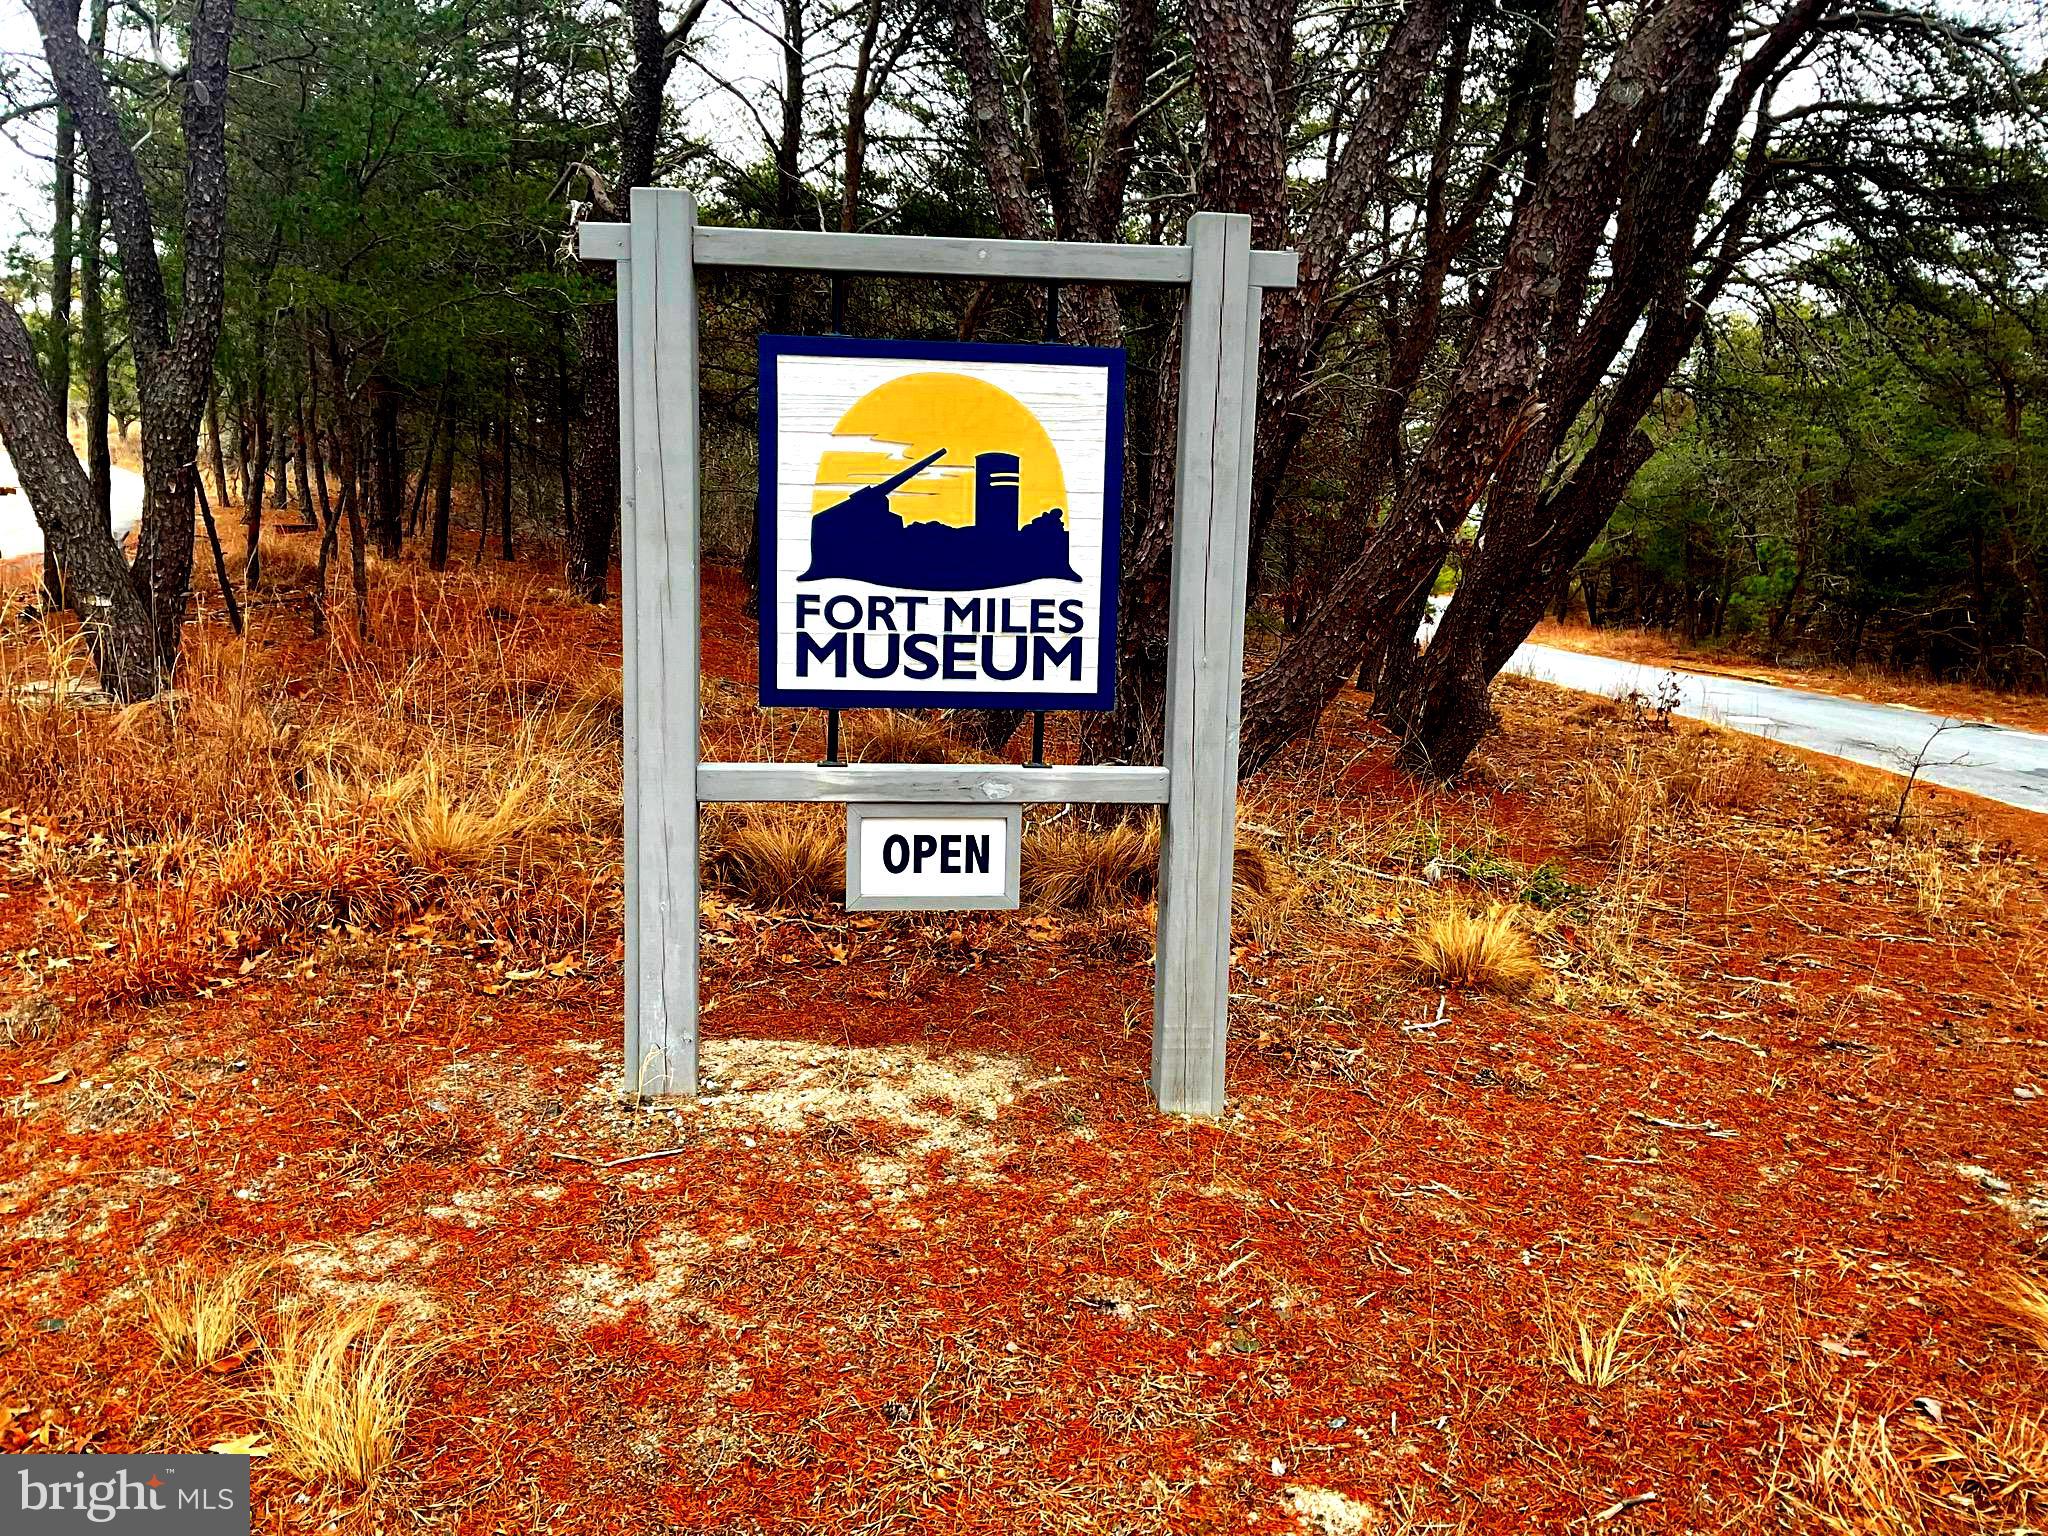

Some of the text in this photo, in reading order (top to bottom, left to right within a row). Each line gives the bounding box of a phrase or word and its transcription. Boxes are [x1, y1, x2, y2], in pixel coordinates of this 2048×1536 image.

[796, 594, 1084, 634] FORT MILES
[796, 631, 1083, 681] MUSEUM
[882, 833, 990, 874] OPEN
